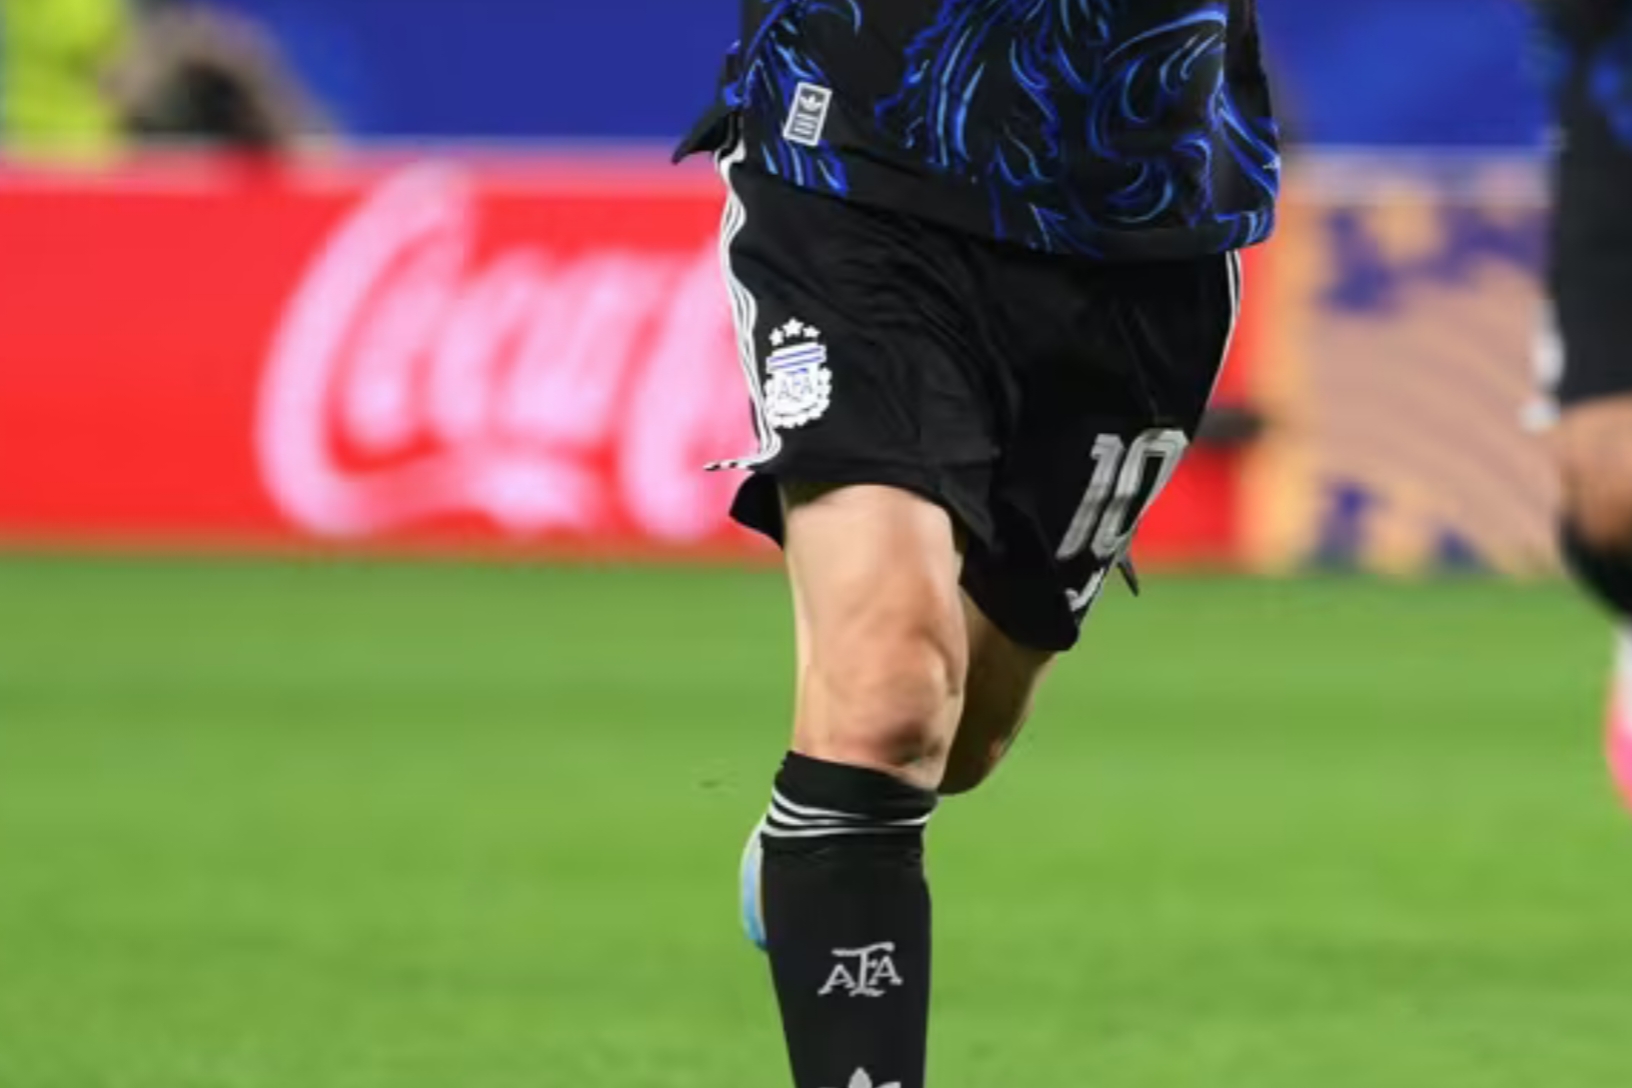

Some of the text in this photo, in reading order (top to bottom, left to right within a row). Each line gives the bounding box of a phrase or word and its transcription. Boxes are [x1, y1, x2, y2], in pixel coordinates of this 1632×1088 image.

[250, 156, 758, 538] Coca-C
[1055, 427, 1190, 560] 10
[818, 941, 904, 997] AFA
